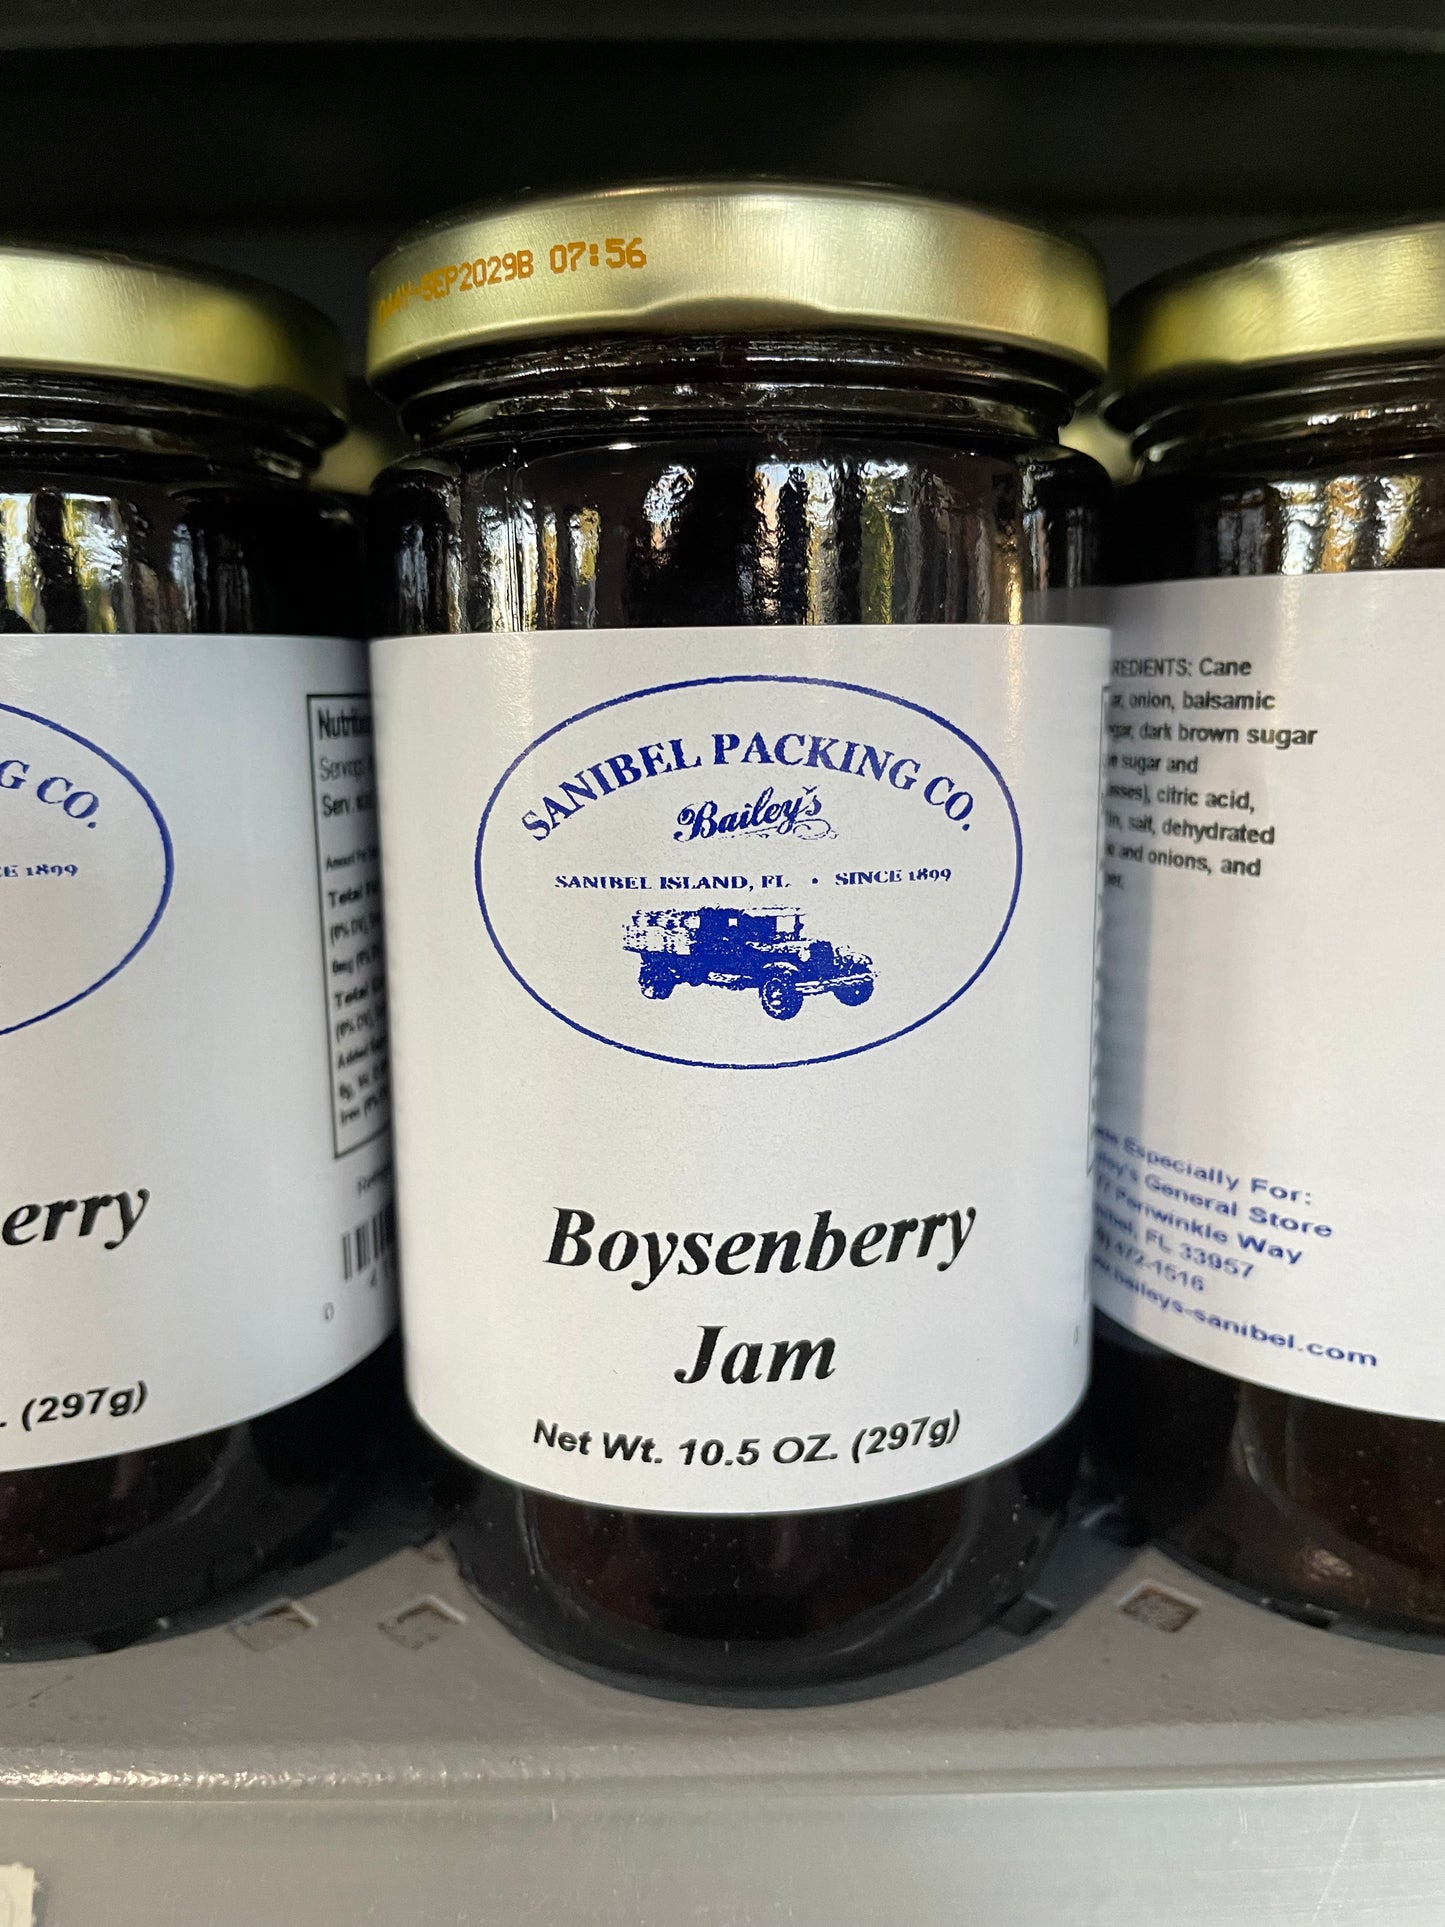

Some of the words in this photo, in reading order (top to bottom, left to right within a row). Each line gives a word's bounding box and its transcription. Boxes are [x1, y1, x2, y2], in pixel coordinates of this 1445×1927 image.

[550, 238, 647, 274] 07:56
[1199, 657, 1252, 677] Cane
[1130, 692, 1176, 713] onion,
[1182, 690, 1276, 711] balsamic
[1139, 723, 1172, 741] dark
[1178, 724, 1239, 743] brown
[1247, 728, 1318, 750] sugar
[521, 738, 701, 841] SANIBEL
[712, 732, 921, 790] PACKING
[923, 775, 975, 832] CO.
[1122, 755, 1161, 775] sugar
[1167, 756, 1199, 774] and
[37, 776, 99, 829] CO.
[673, 785, 838, 842] Bailey's
[1157, 785, 1199, 806] citric
[1205, 790, 1255, 814] acid,
[1128, 815, 1155, 835] salt,
[1162, 817, 1276, 845] dehydrated
[26, 864, 78, 877] 1899
[554, 874, 653, 890] SANIBEL
[659, 875, 754, 892] ISLAND,
[835, 868, 902, 886] SINCE
[908, 867, 952, 882] 1899
[1118, 844, 1143, 862] and
[1148, 849, 1213, 875] onions,
[1220, 858, 1261, 877] and
[1124, 1135, 1239, 1191] Especially
[1251, 1177, 1311, 1205] For:
[1115, 1189, 1228, 1245] Periwinkle
[1237, 1232, 1303, 1265] Way
[1145, 1174, 1238, 1217] General
[1249, 1206, 1333, 1238] Store
[542, 1206, 976, 1291] Boysenberry
[1146, 1229, 1171, 1252] FL
[1180, 1243, 1255, 1279] 33957
[674, 1325, 837, 1385] Jam
[22, 1380, 149, 1432] (297g)
[532, 1418, 593, 1455] Net
[602, 1432, 663, 1464] Wt.
[678, 1438, 760, 1466] 10.5
[773, 1434, 838, 1463] OZ.
[851, 1409, 961, 1463] (297g)
